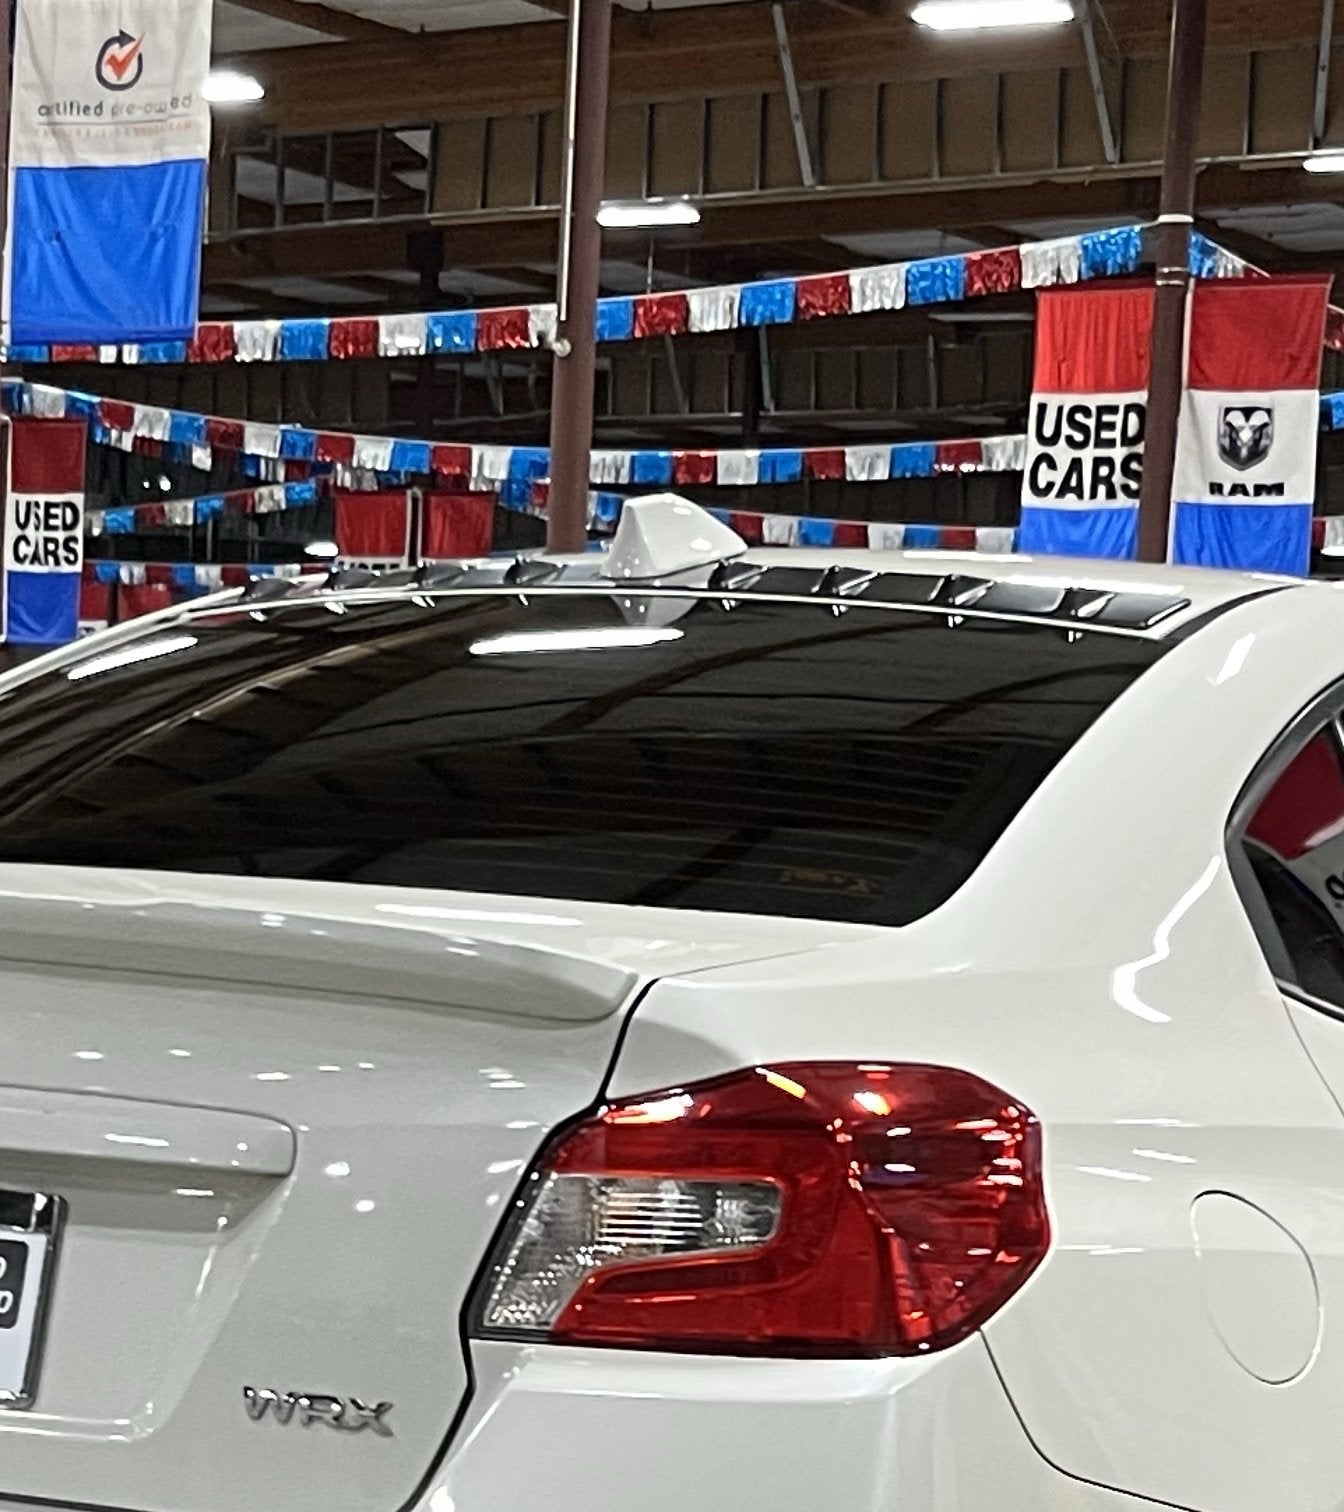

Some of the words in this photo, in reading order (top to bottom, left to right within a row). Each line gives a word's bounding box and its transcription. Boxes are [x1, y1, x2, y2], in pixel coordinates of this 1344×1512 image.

[1035, 402, 1146, 450] USED
[1029, 452, 1142, 501] CARS
[1209, 481, 1284, 497] RAM
[15, 500, 80, 532] USED
[13, 535, 79, 566] CARS
[243, 1386, 394, 1438] WRX
